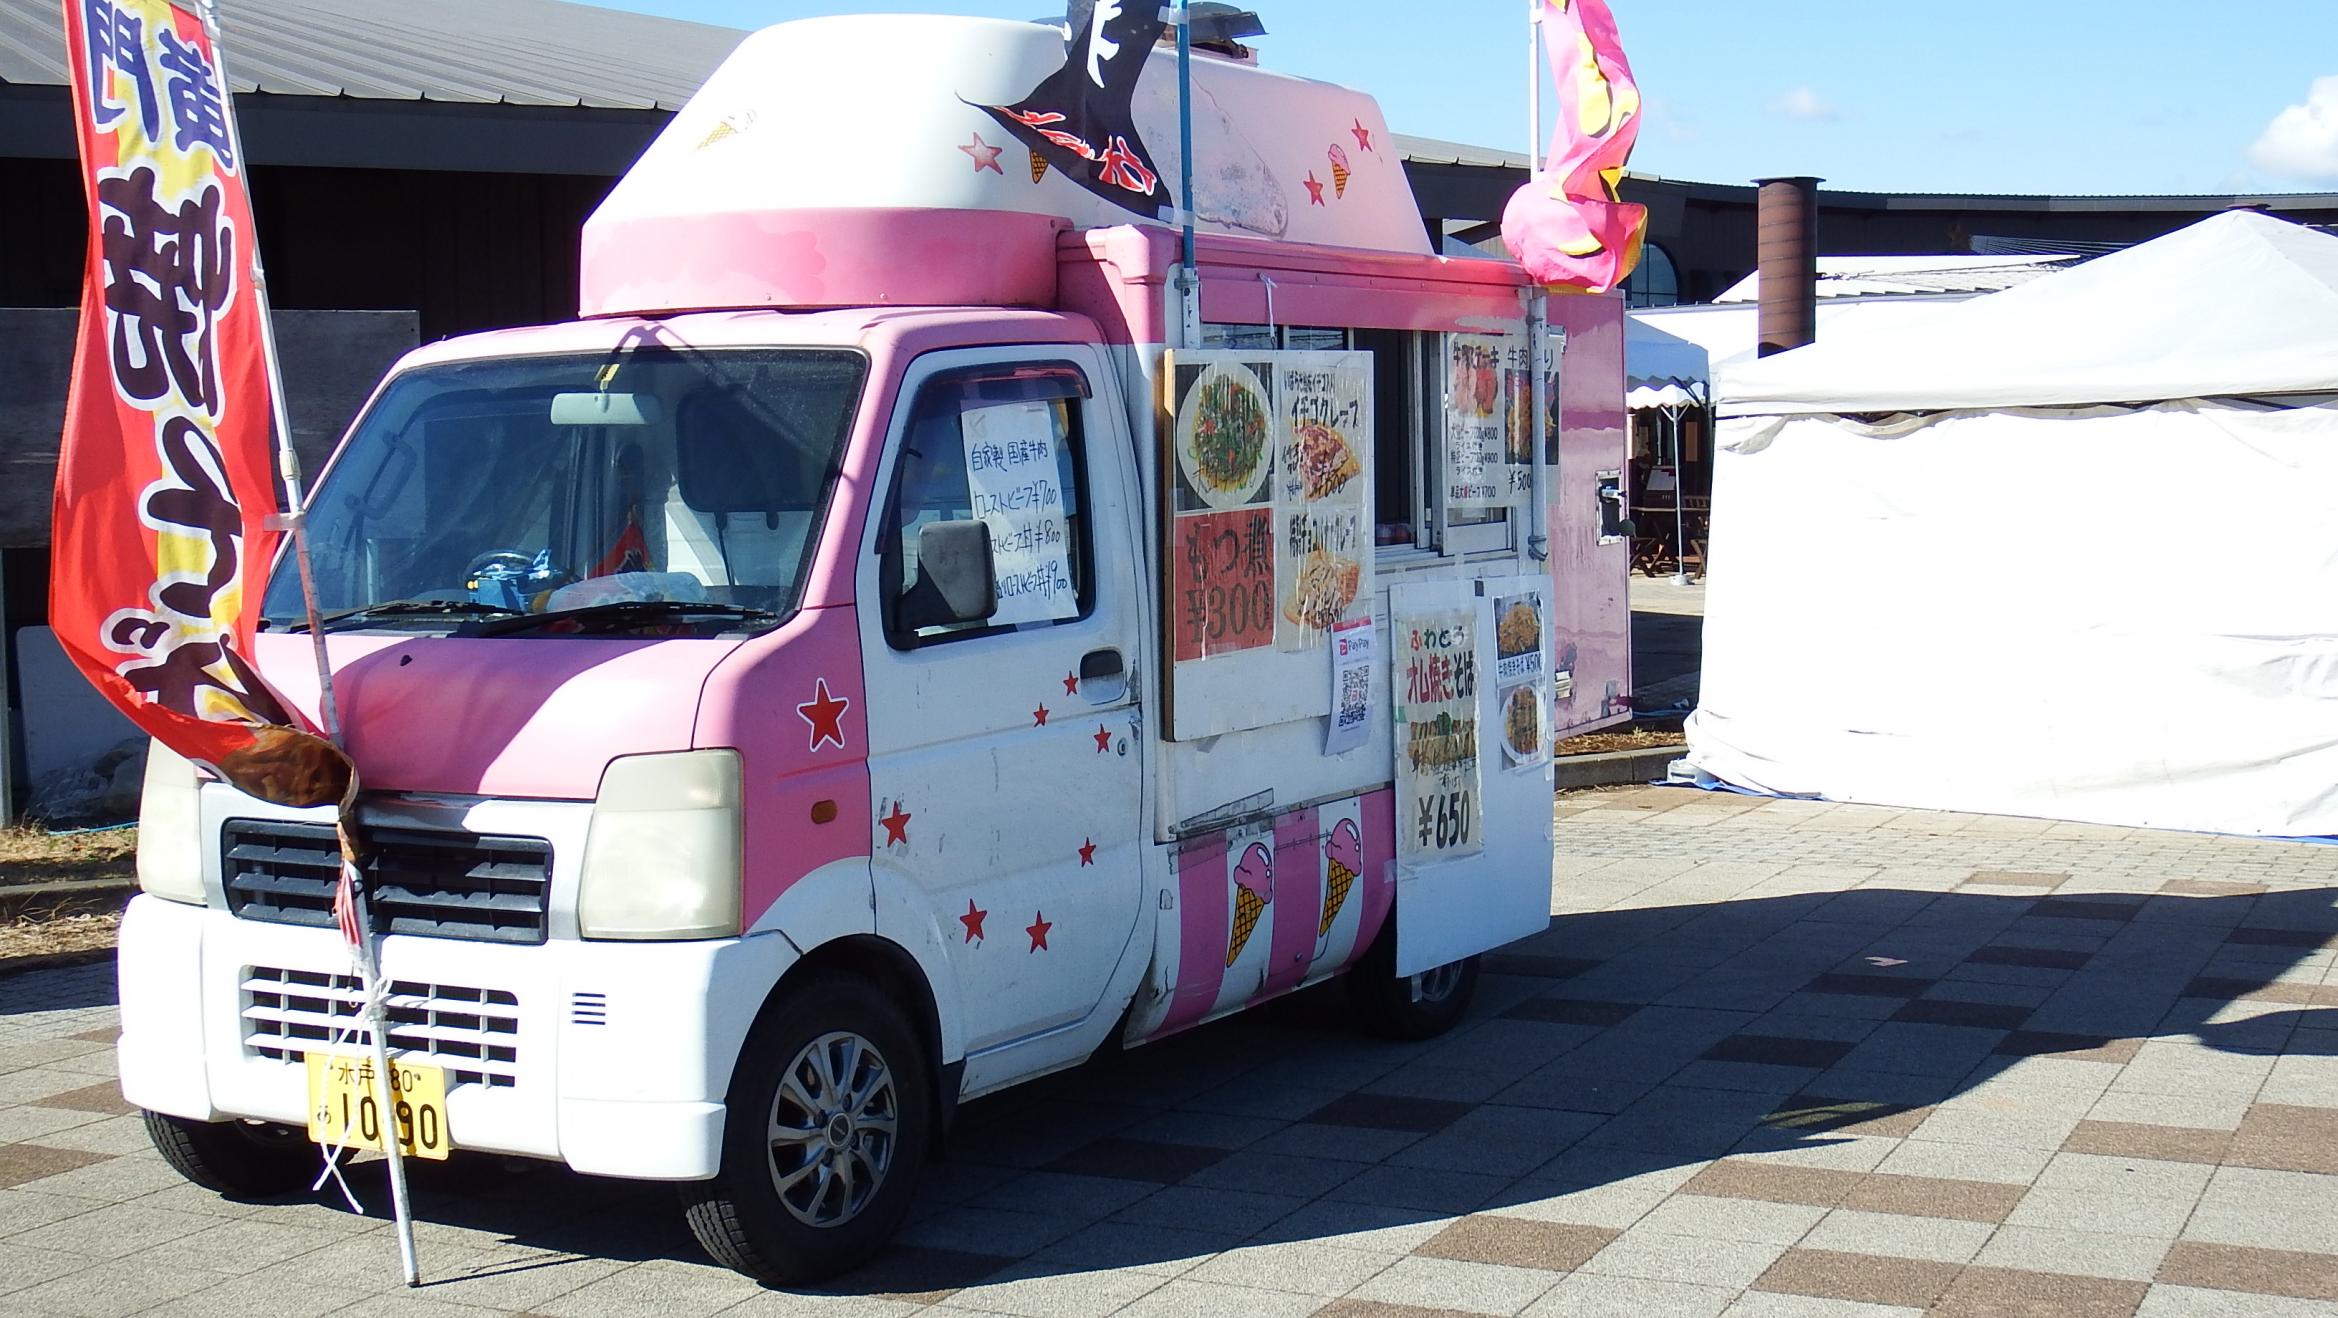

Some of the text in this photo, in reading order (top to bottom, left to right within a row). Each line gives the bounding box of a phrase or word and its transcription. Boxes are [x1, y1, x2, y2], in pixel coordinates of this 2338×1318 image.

[970, 438, 1048, 472] 自家製 国産牛肉
[1186, 515, 1270, 583] もつ煮
[1185, 580, 1270, 643] ¥300
[1347, 637, 1370, 654] PayPay
[1406, 650, 1475, 705] オム焼きそば
[1418, 790, 1470, 850] ¥650
